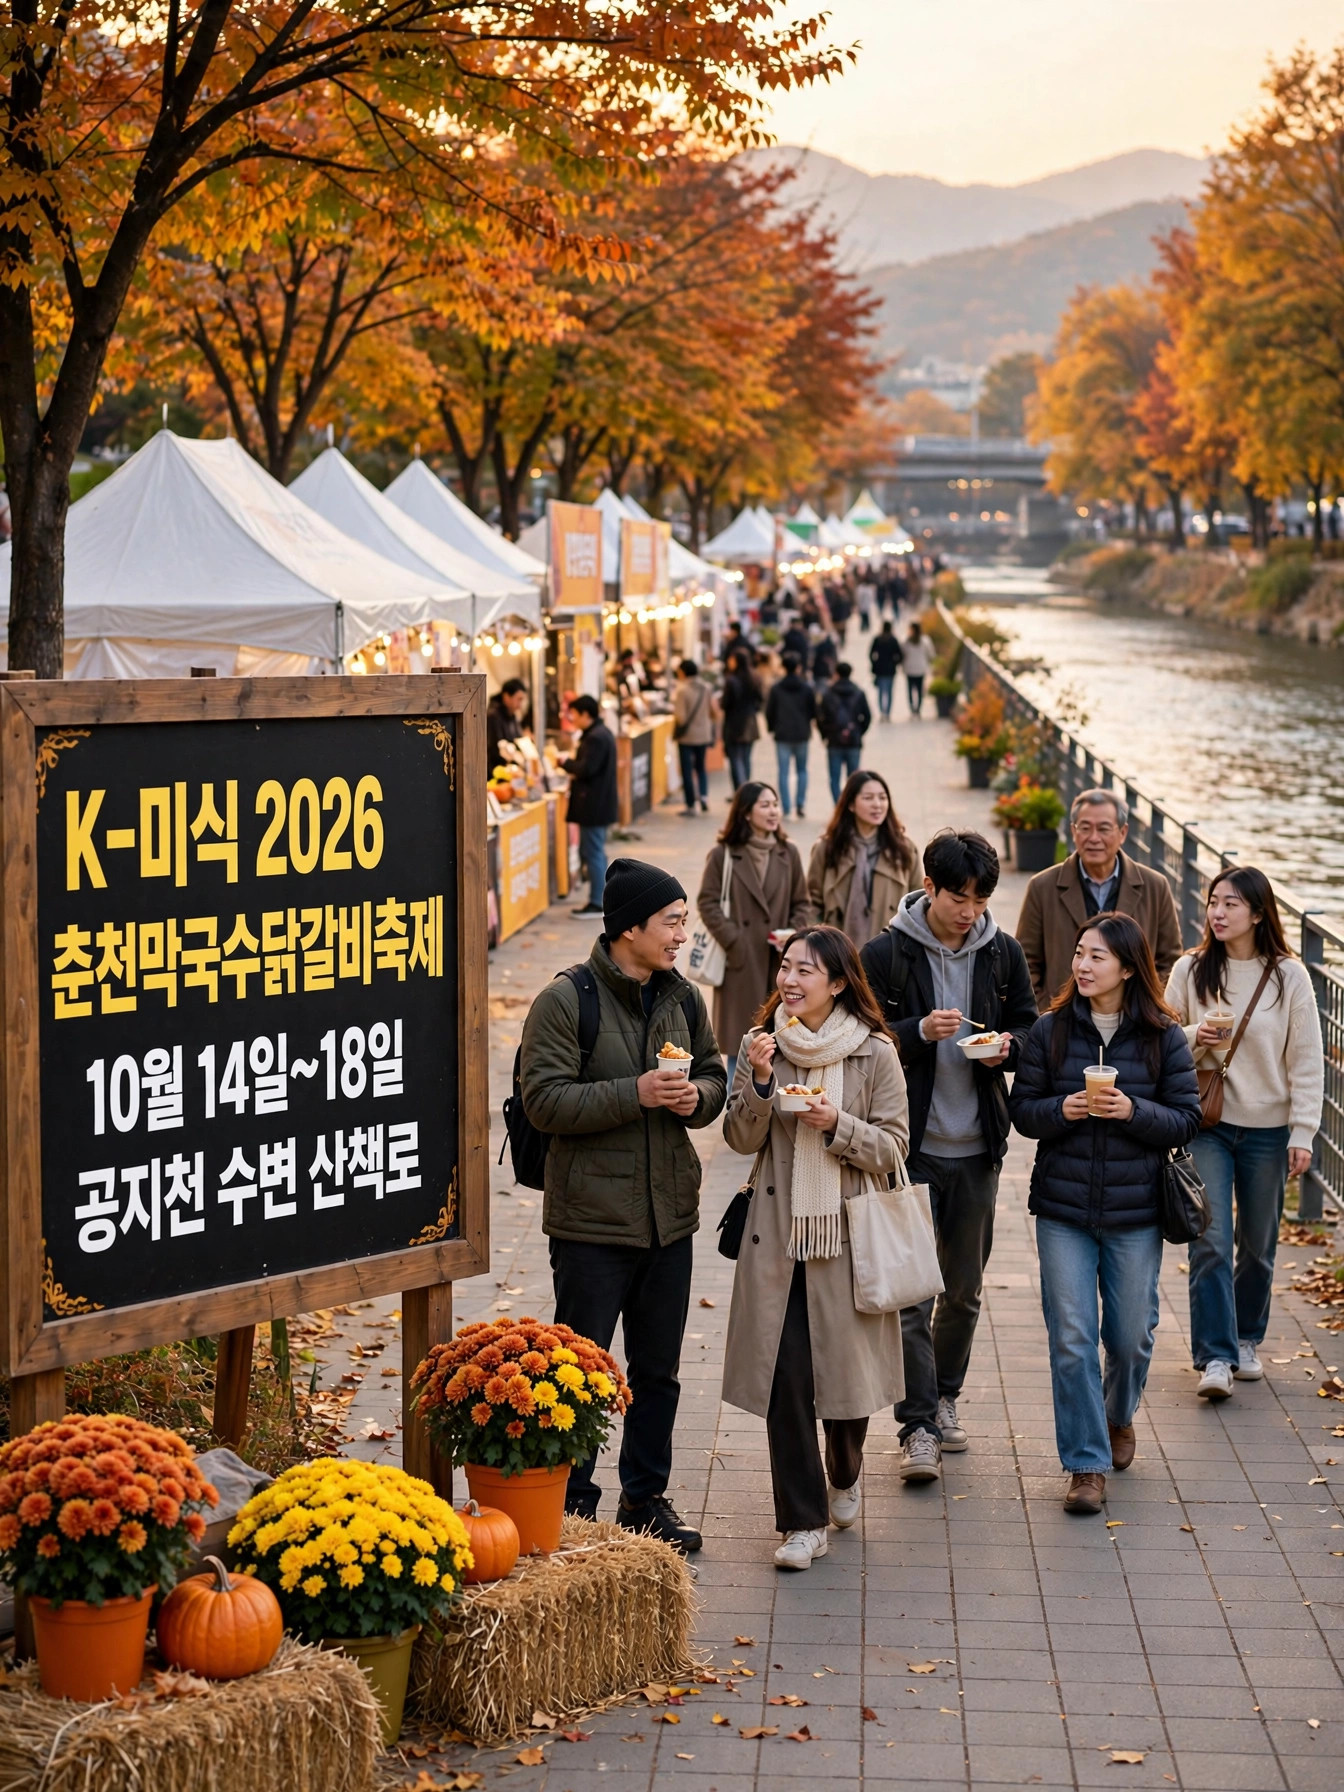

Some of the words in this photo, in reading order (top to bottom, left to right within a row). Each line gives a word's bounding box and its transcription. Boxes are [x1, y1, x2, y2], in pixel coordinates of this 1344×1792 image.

[66, 779, 239, 892] K-미식
[255, 774, 385, 878] 2026
[51, 894, 444, 1020] 춘천막국수닭갈비축제
[86, 1044, 184, 1136] 10월
[197, 1018, 404, 1119] 14일~18일
[74, 1150, 206, 1254] 공지천
[218, 1136, 297, 1226] 수변
[308, 1120, 422, 1211] 산책로
